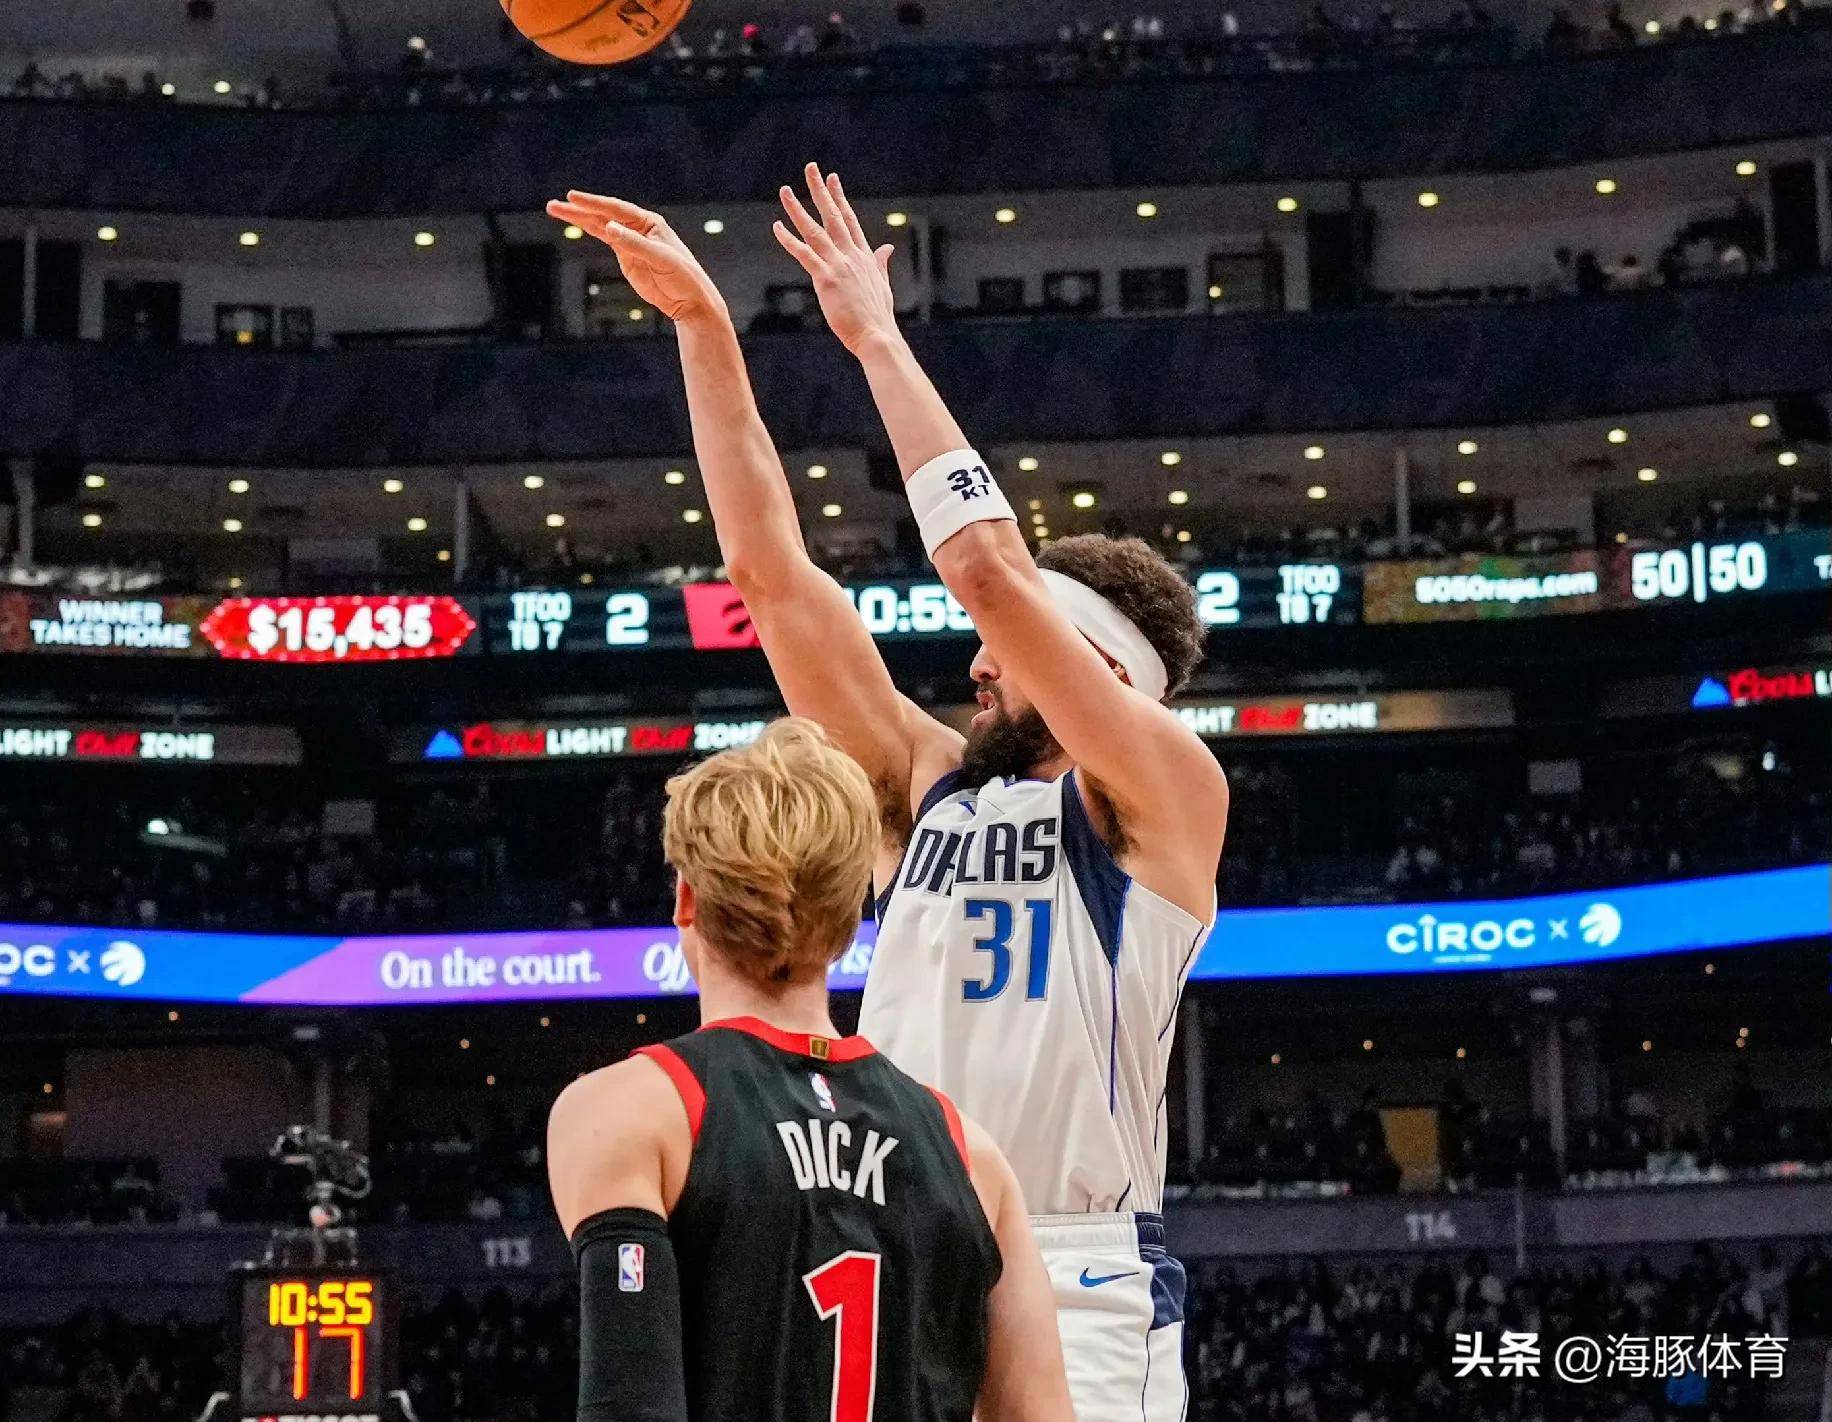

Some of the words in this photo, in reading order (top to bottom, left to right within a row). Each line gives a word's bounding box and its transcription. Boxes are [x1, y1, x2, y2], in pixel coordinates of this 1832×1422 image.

[947, 465, 990, 491] 31
[961, 484, 989, 501] KT
[1813, 554, 1832, 579] T
[59, 599, 163, 622] WINNER
[606, 594, 649, 645] 2
[844, 584, 976, 634] 0:55
[1197, 572, 1240, 624] 2
[30, 619, 113, 646] TAKES
[114, 622, 191, 649] HOME
[248, 604, 432, 656] $15,435
[1303, 701, 1378, 731] ZONE
[0, 728, 71, 757] IGHT
[140, 732, 214, 760] ZONE
[547, 726, 628, 756] LIGHT
[380, 950, 434, 988] On
[441, 947, 497, 987] the
[502, 950, 601, 986] court.
[961, 897, 1054, 1003] 31
[776, 1118, 900, 1206] DICK
[269, 1281, 373, 1326] 10:55
[802, 1249, 882, 1422] 1
[293, 1326, 365, 1401] 17
